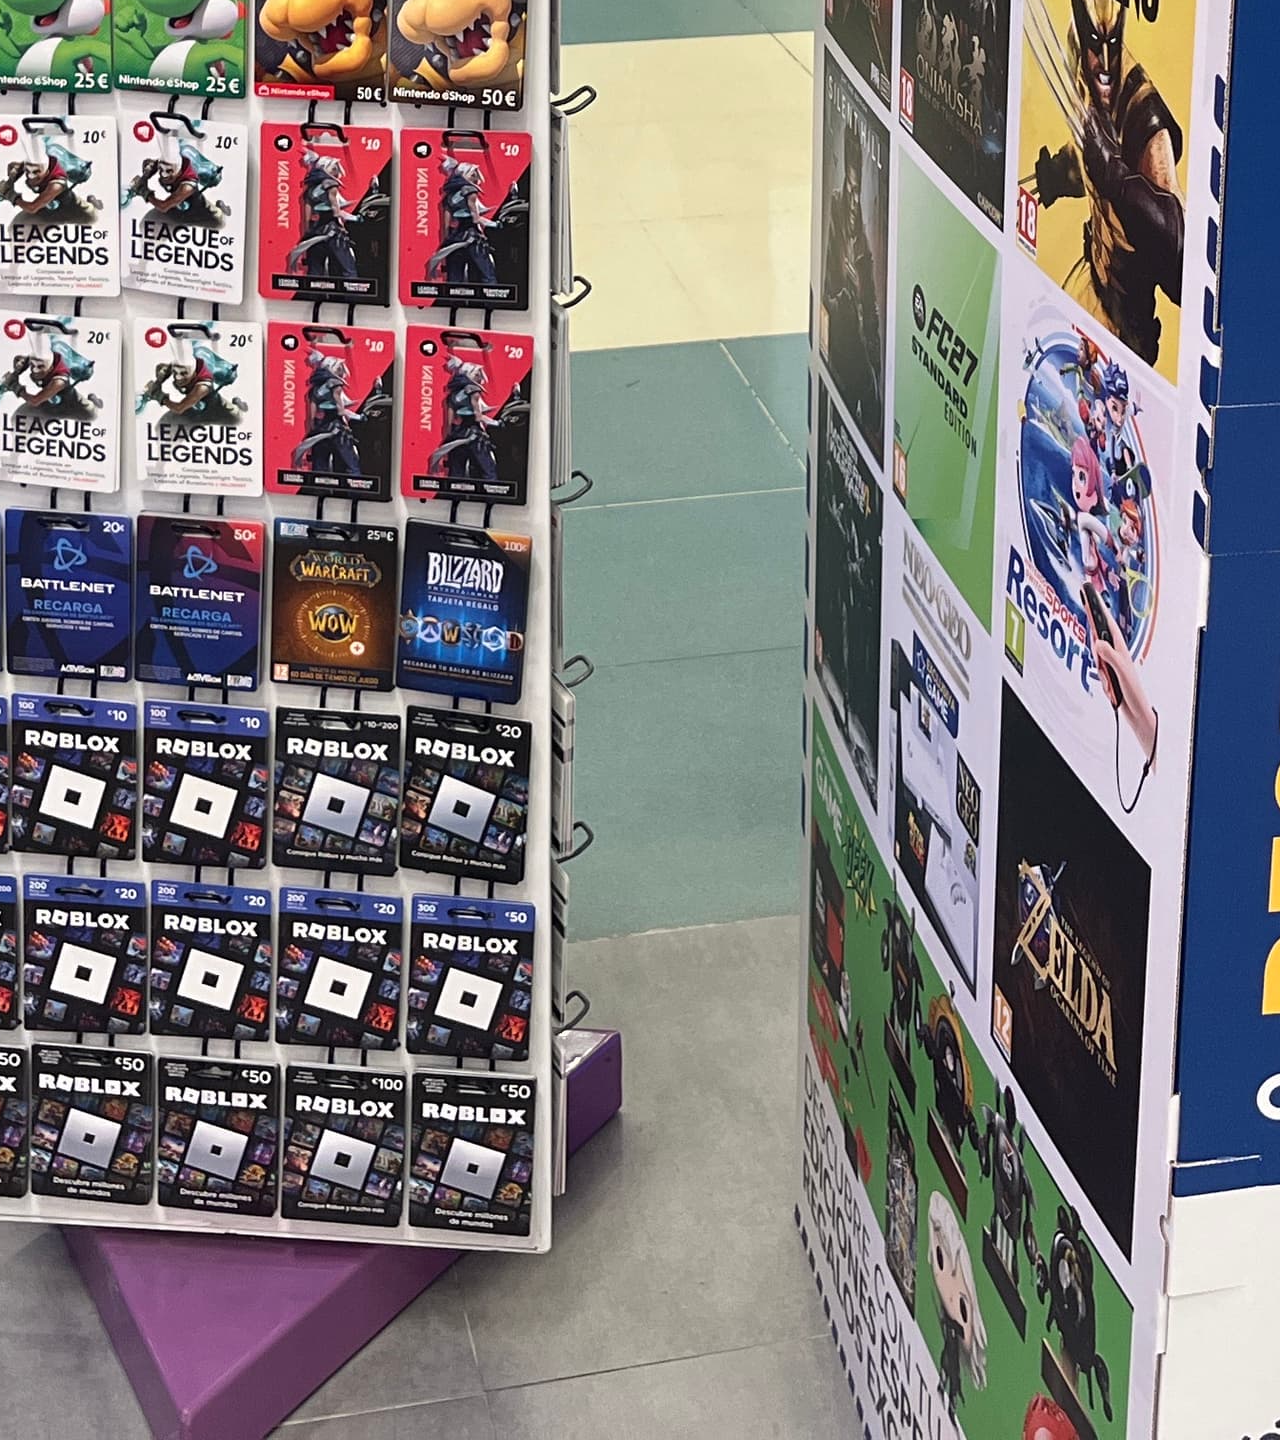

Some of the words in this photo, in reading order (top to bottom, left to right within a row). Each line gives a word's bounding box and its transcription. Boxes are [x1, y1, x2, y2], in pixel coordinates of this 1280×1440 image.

[393, 88, 440, 101] Nintendo
[901, 76, 913, 115] 18
[917, 54, 982, 136] ONIMUSHA
[828, 76, 858, 135] SILENT
[860, 119, 882, 169] HILL
[278, 160, 289, 229] VALORANT
[416, 168, 429, 236] VALORANT
[0, 223, 92, 244] LEAGUE
[93, 231, 108, 240] OF
[131, 219, 219, 248] LEAGUE
[220, 236, 234, 245] OF
[1020, 193, 1037, 240] 18
[0, 245, 108, 266] LEGENDS
[130, 240, 234, 272] LEGENDS
[926, 307, 979, 387] FC27
[284, 359, 295, 426] VALORANT
[912, 335, 968, 419] STANDARD
[420, 365, 433, 432] VALORANT
[2, 436, 106, 462] LEGENDS
[945, 403, 977, 458] EDITION
[300, 561, 369, 582] WARCRAFT
[427, 552, 504, 593] BLIZZARD
[34, 598, 102, 614] RECARGA
[162, 607, 231, 622] RECARGA
[428, 595, 463, 606] TARJETA
[1007, 545, 1090, 693] Resort
[308, 611, 360, 633] WOW
[25, 730, 119, 752] ROBLOX
[156, 738, 251, 760] ROBLOX
[287, 737, 388, 760] ROBLOX
[1018, 859, 1118, 1072] ZELDA
[995, 995, 1011, 1037] 12
[1097, 1051, 1116, 1088] TIME
[54, 1176, 89, 1188] Descubre
[91, 1181, 124, 1191] millones
[80, 1188, 111, 1197] mundos
[805, 1053, 870, 1277] DESCUBRE
[875, 1263, 911, 1386] CON
